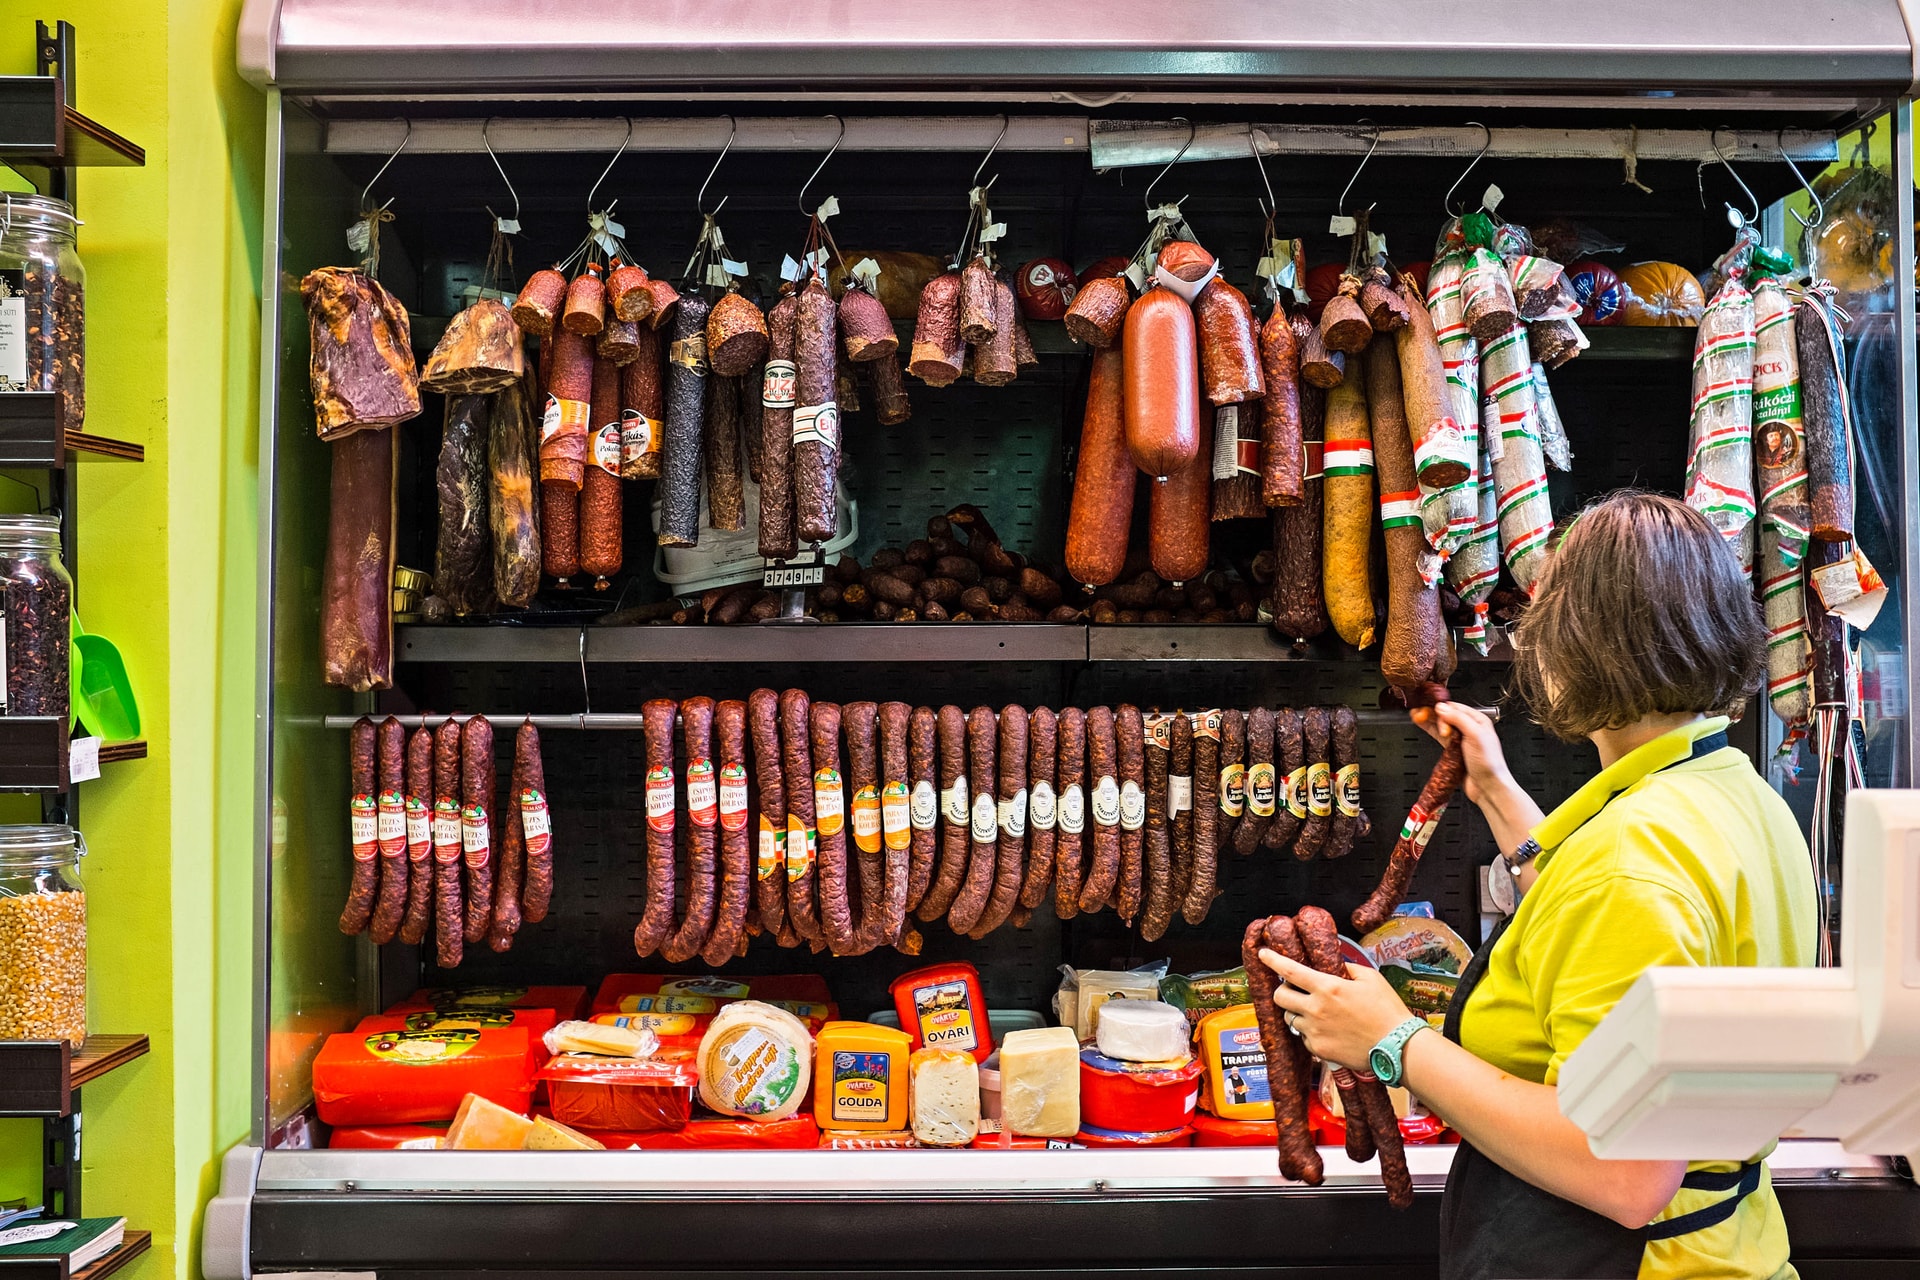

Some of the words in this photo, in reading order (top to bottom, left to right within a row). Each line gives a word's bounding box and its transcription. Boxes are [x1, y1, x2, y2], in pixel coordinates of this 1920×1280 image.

[1753, 361, 1782, 378] PICK
[1753, 391, 1795, 411] Rákóczi
[766, 572, 802, 583] 3749
[928, 1026, 969, 1042] ÓVÁRI
[763, 1043, 779, 1067] sajt
[838, 1096, 883, 1107] GOUDA
